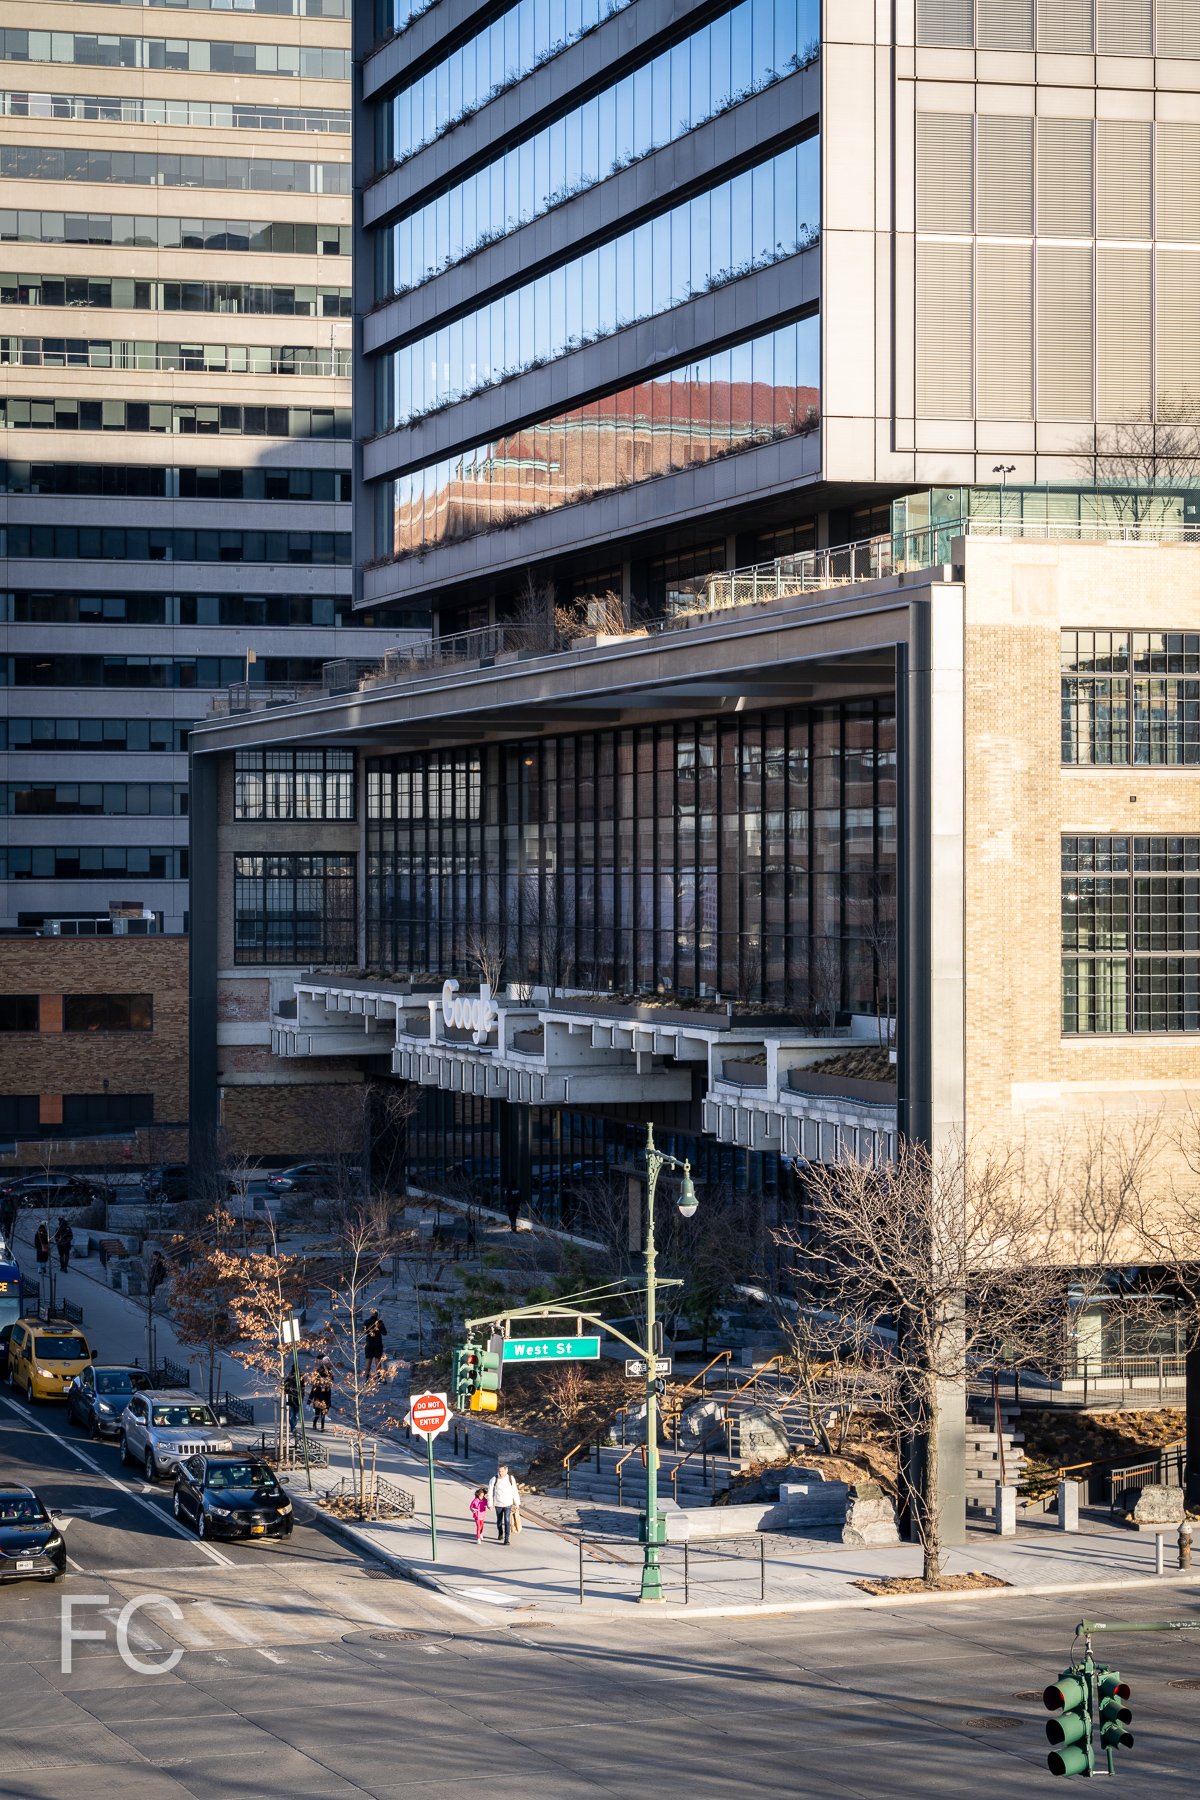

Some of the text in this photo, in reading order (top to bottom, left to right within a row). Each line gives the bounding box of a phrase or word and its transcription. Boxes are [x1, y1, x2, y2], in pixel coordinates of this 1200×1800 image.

[442, 979, 499, 1045] Google
[514, 1342, 573, 1356] West St
[417, 1401, 441, 1410] DO NOT
[419, 1417, 440, 1426] ENTER
